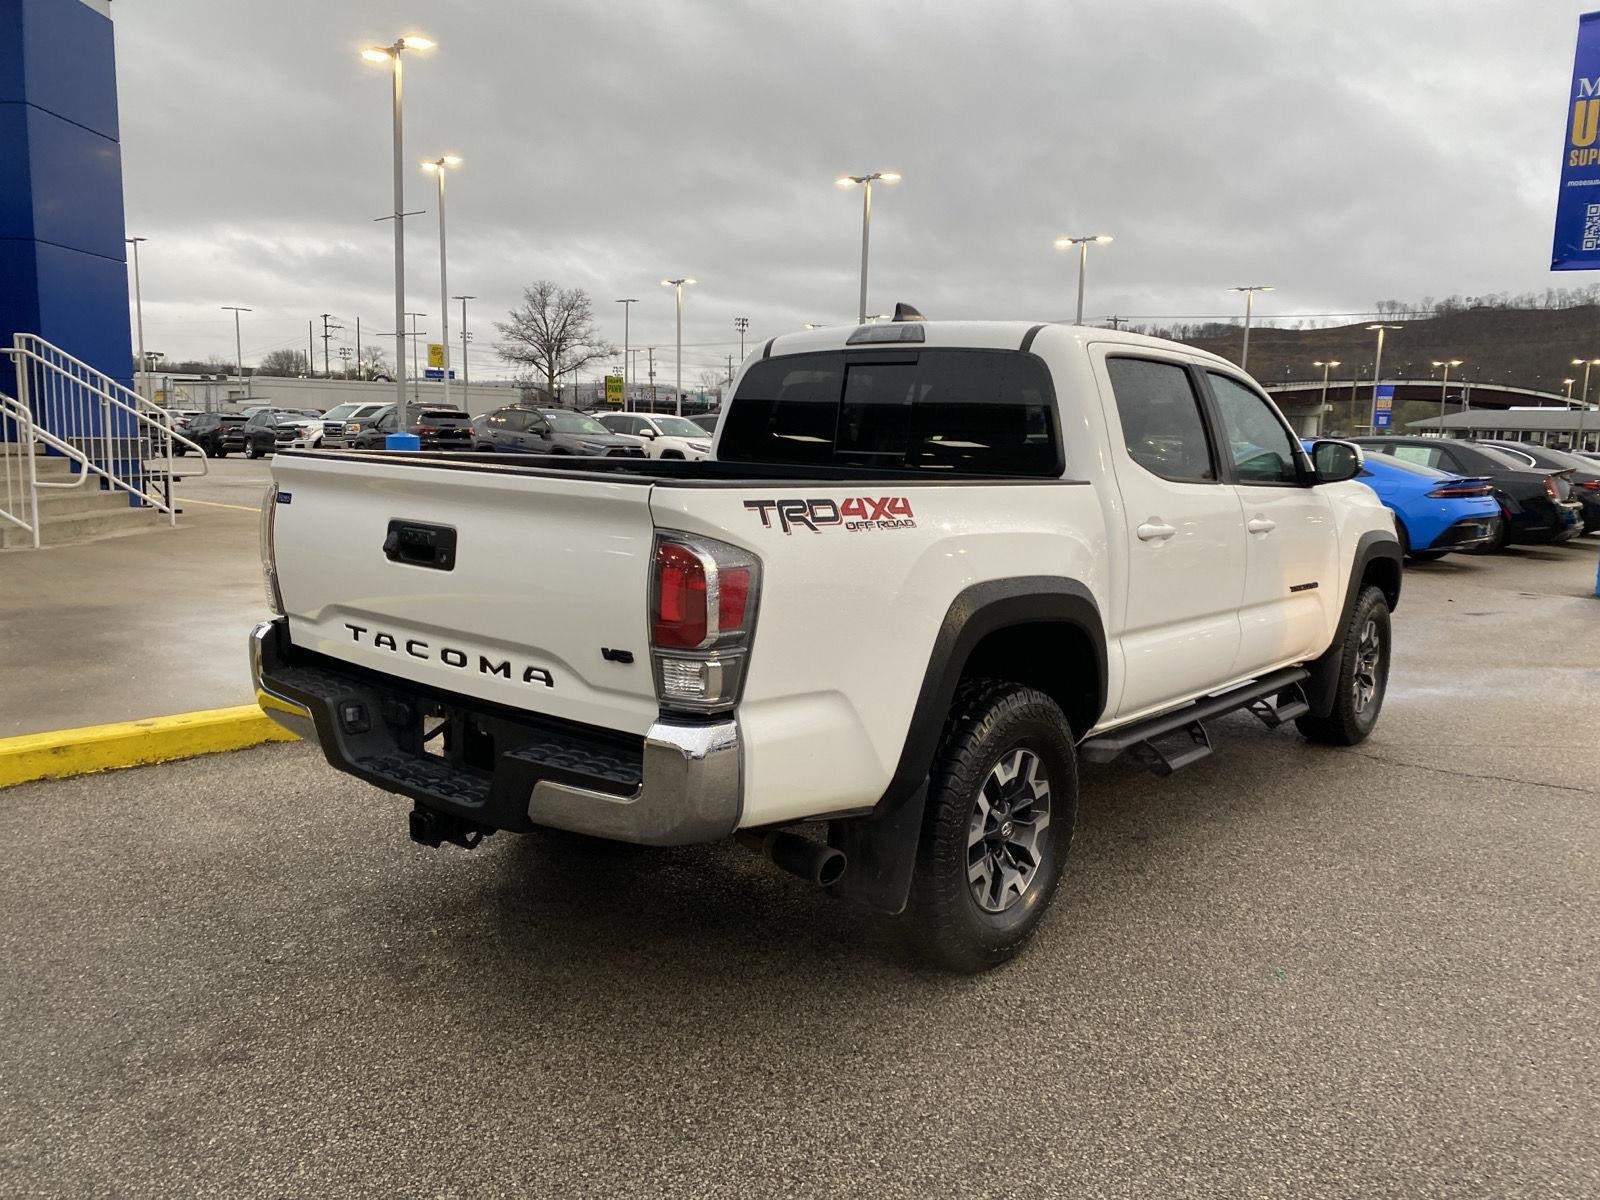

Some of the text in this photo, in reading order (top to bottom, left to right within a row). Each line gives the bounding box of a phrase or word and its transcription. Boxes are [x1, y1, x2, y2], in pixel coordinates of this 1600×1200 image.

[743, 498, 842, 535] TRD
[845, 519, 917, 532] OFF ROAD
[344, 623, 554, 688] TACOMA
